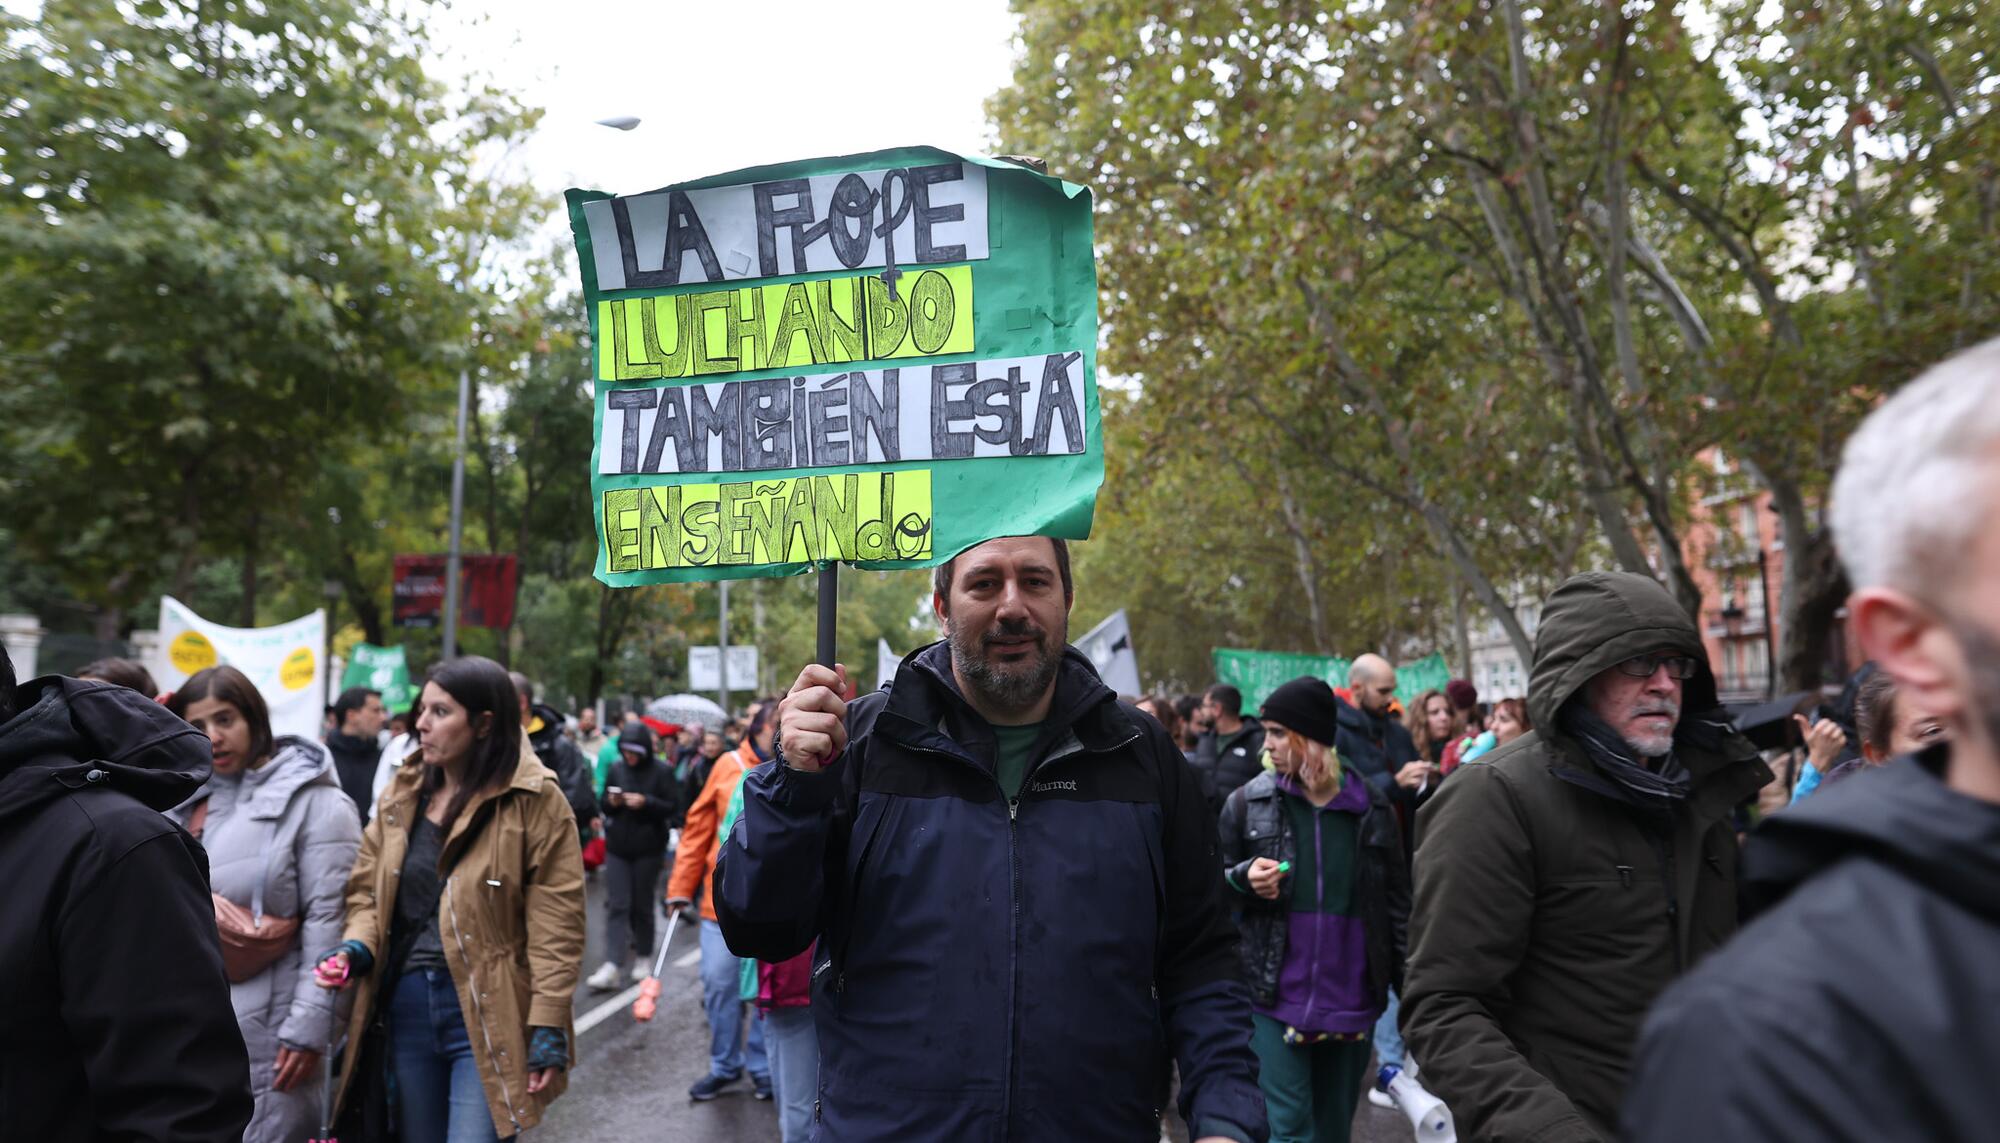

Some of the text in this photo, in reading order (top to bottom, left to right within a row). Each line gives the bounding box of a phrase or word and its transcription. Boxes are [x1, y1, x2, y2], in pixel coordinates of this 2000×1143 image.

[612, 191, 724, 289] LA
[610, 270, 956, 380] LUCHANDO
[1031, 780, 1077, 792] Marmot
